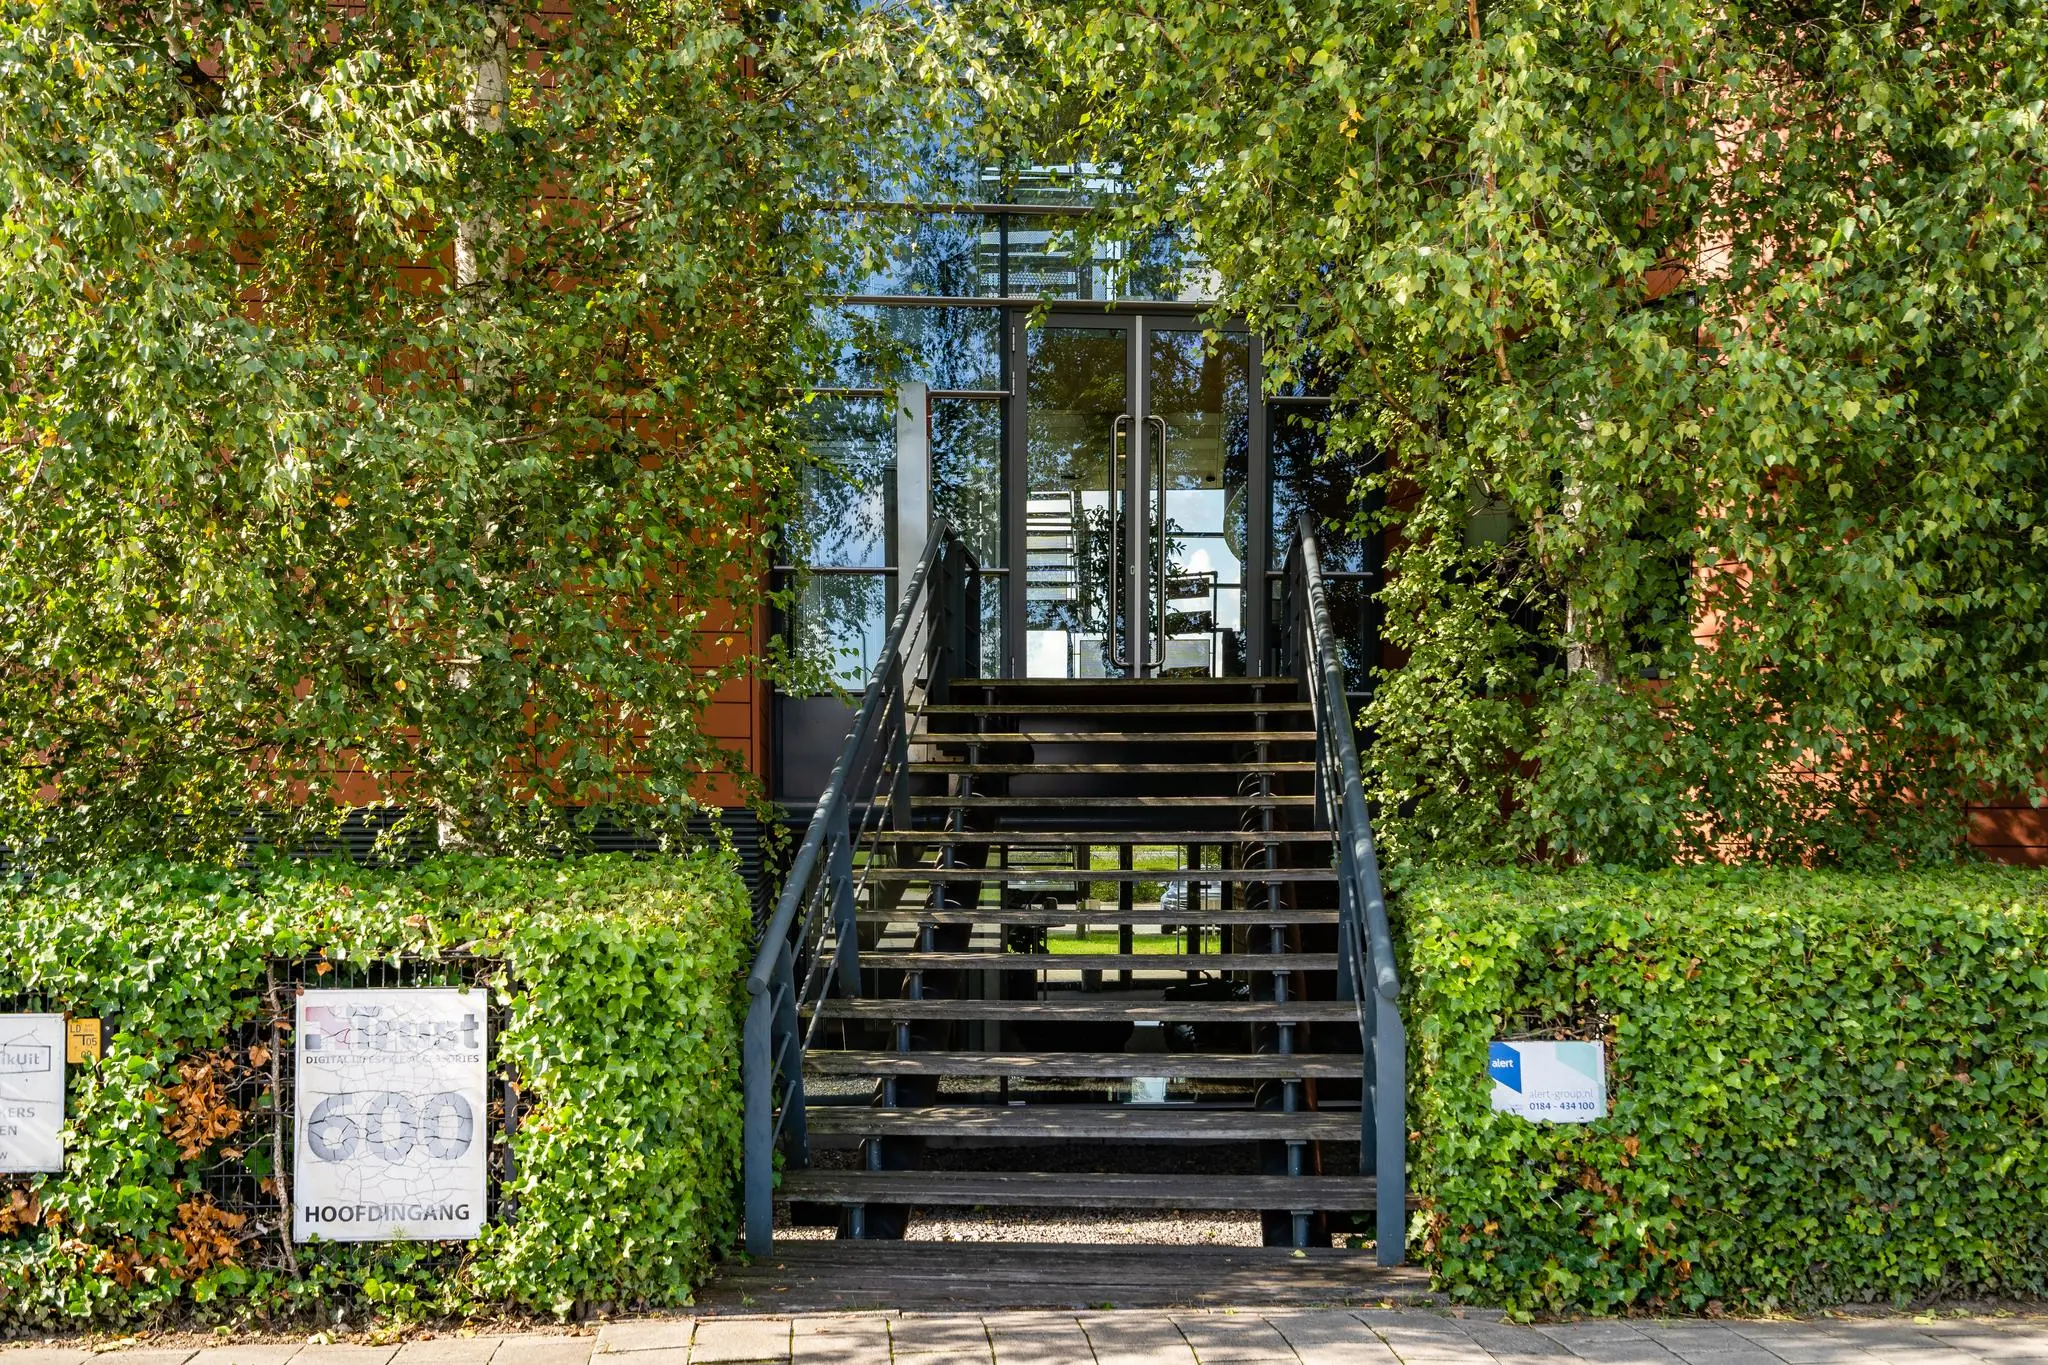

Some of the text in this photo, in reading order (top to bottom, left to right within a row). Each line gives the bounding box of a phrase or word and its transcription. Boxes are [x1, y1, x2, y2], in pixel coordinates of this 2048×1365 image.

[86, 1038, 97, 1046] 05
[1491, 1059, 1514, 1068] alert
[1529, 1089, 1594, 1100] alert-group.nl
[1529, 1102, 1551, 1110] 0184
[1559, 1102, 1576, 1110] 434
[1579, 1102, 1595, 1110] 100
[307, 1092, 474, 1163] 600
[305, 1204, 470, 1223] HOOFDINGANG
